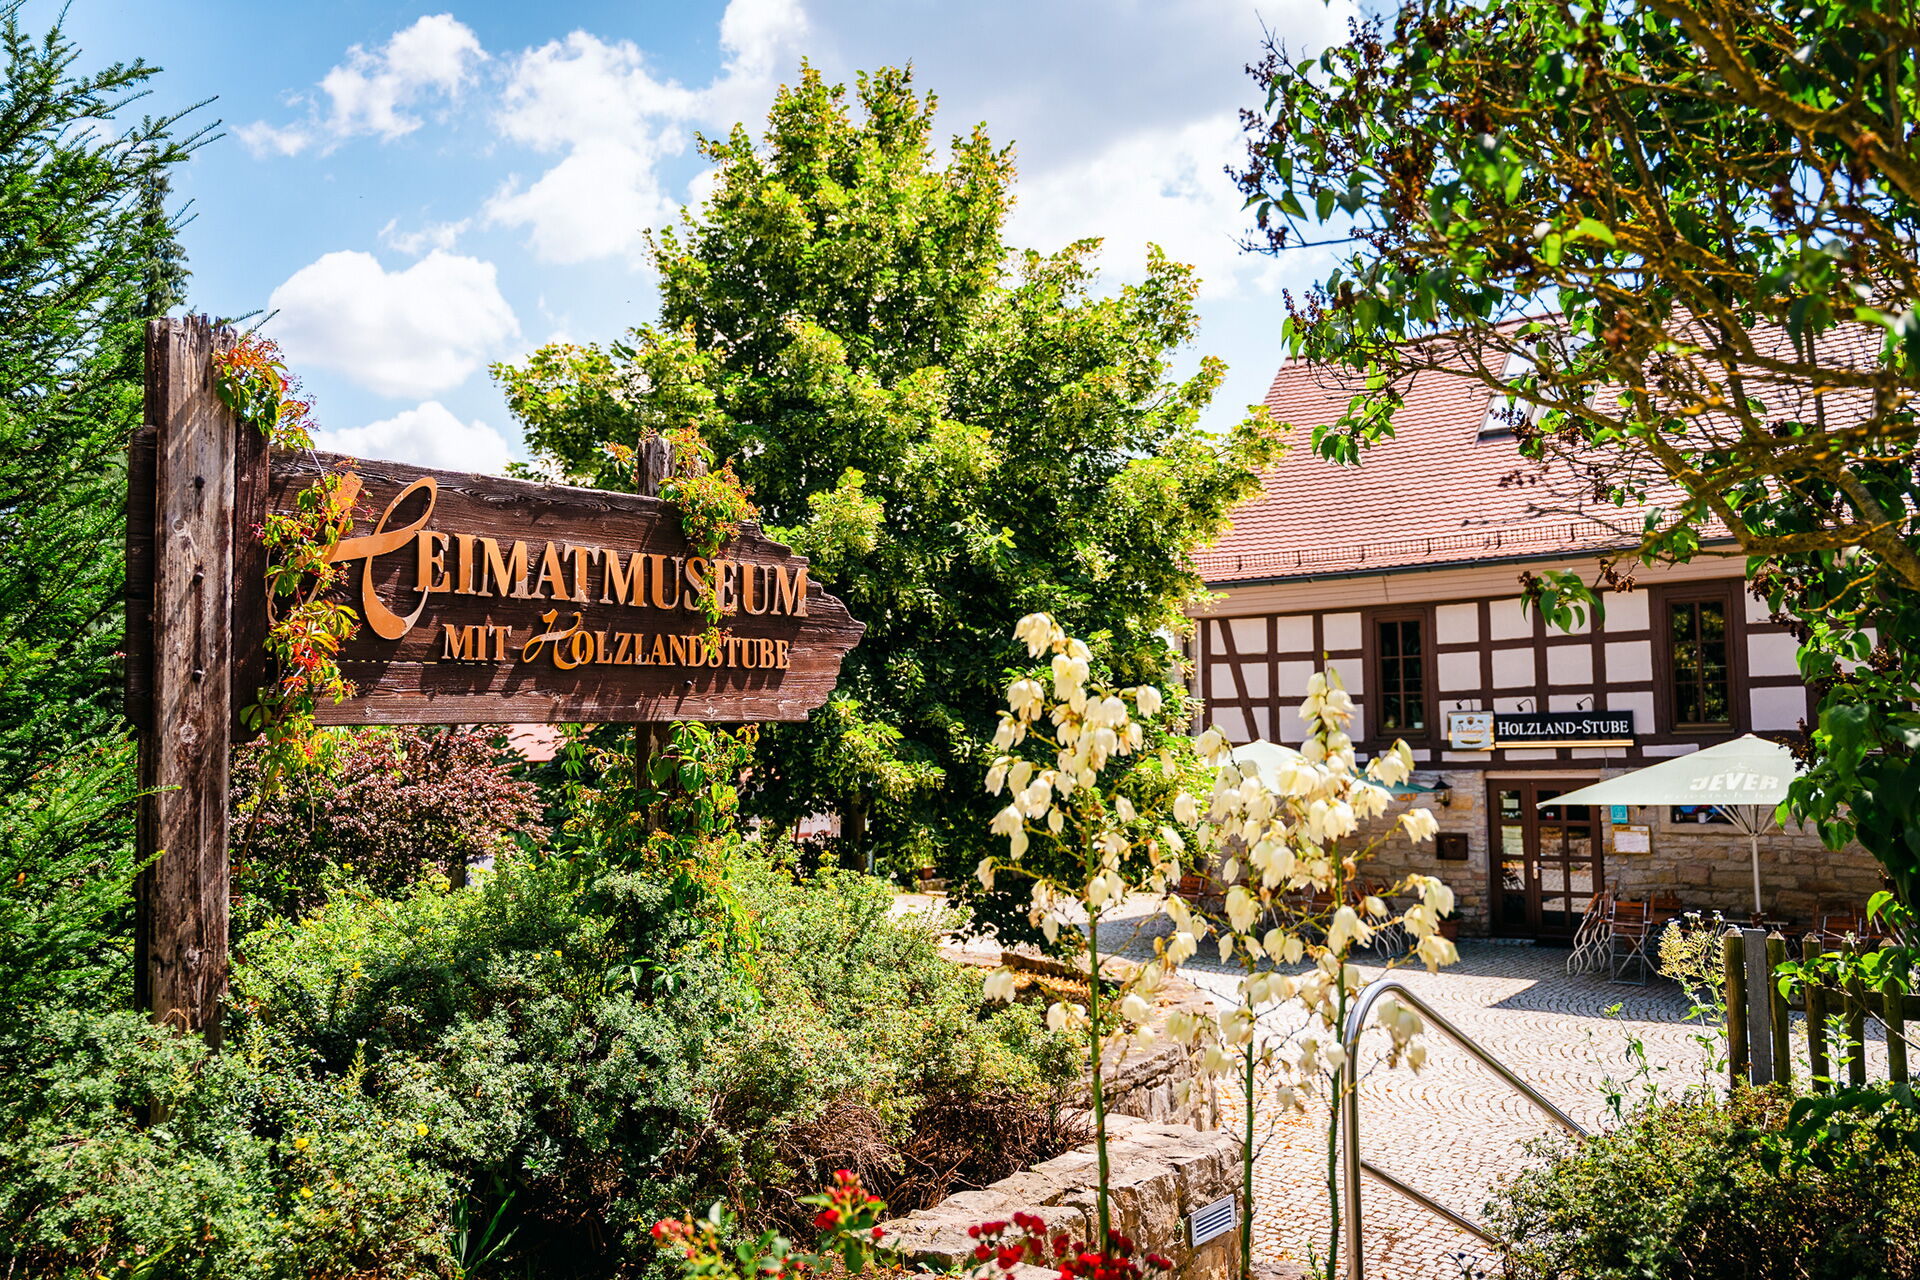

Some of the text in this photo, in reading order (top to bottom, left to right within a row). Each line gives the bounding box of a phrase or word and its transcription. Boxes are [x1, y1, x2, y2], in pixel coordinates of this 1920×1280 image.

[441, 623, 512, 661] MIT
[1497, 719, 1630, 736] HOLZLAND-STUBE
[1688, 772, 1779, 792] JEVER
